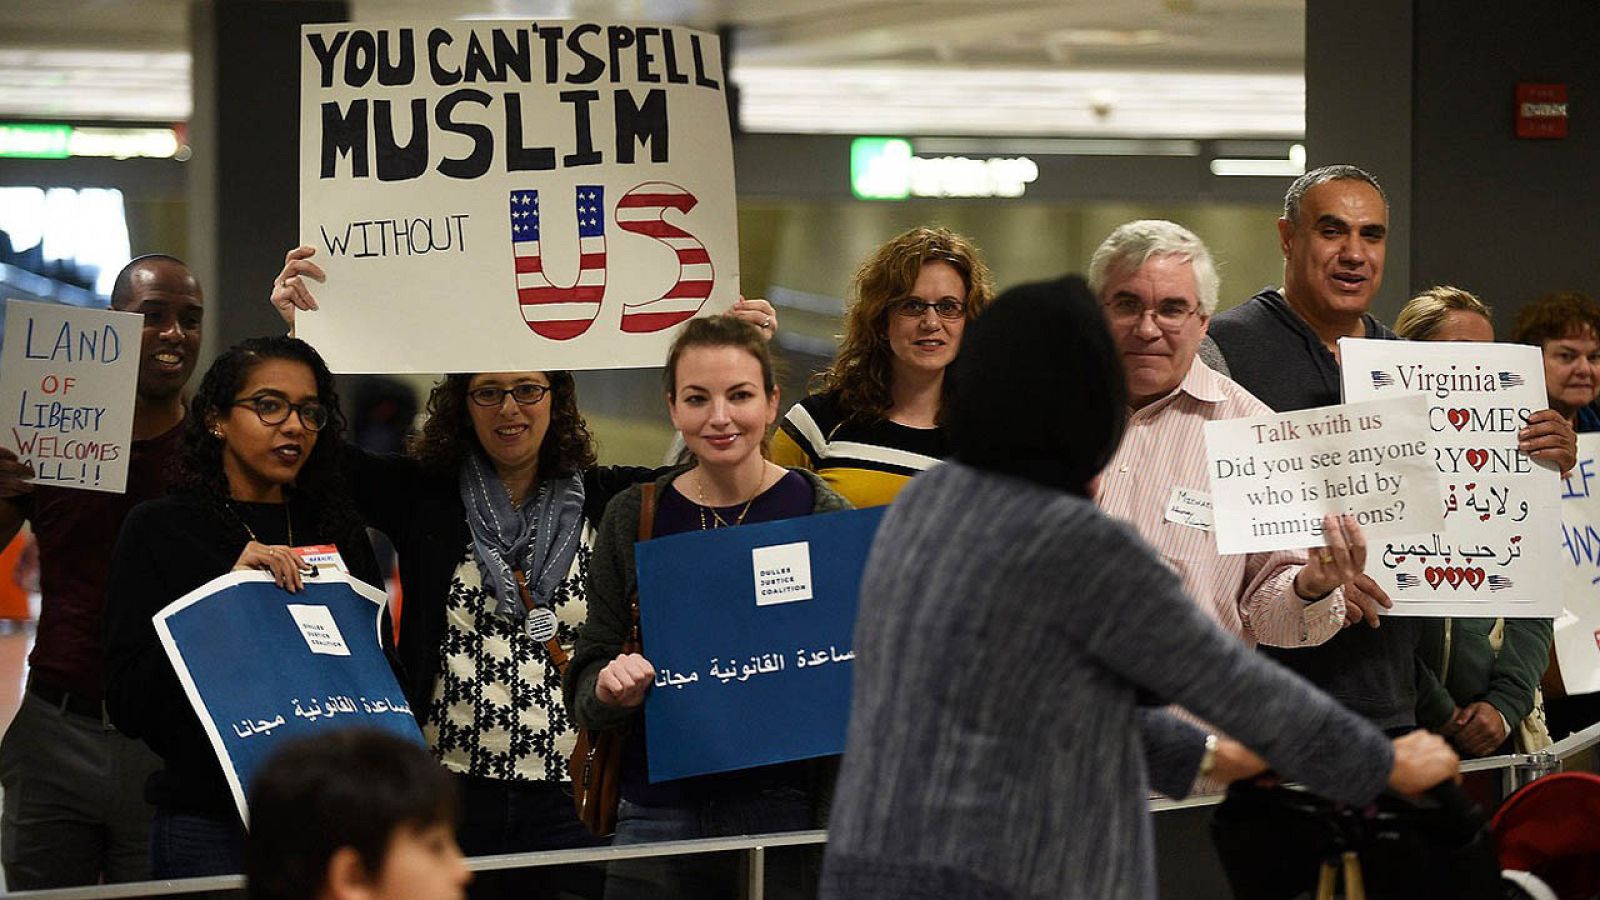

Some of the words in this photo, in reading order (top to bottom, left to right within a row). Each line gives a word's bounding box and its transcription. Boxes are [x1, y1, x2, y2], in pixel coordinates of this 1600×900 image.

[306, 28, 415, 88] YOU
[565, 24, 720, 90] SPELL
[320, 88, 669, 181] MUSLIM
[320, 214, 469, 257] WITHOUT
[510, 181, 715, 341] US
[25, 318, 120, 363] LAND
[41, 375, 76, 395] OF
[1396, 364, 1497, 399] Virginia
[19, 390, 106, 433] LIBERTY
[1252, 421, 1300, 445] Talk
[1307, 414, 1352, 438] with
[1359, 414, 1382, 431] us
[12, 427, 121, 462] WELCOMES
[1216, 457, 1256, 479] Did
[1263, 454, 1304, 480] you
[1310, 450, 1342, 470] see
[1348, 440, 1427, 467] anyone
[1247, 485, 1293, 507] who
[1301, 482, 1319, 502] is
[1325, 474, 1369, 499] held
[1375, 472, 1402, 496] by
[1252, 500, 1405, 537] immigons?
[709, 653, 785, 684] القانونية
[232, 713, 286, 738] مجانا
